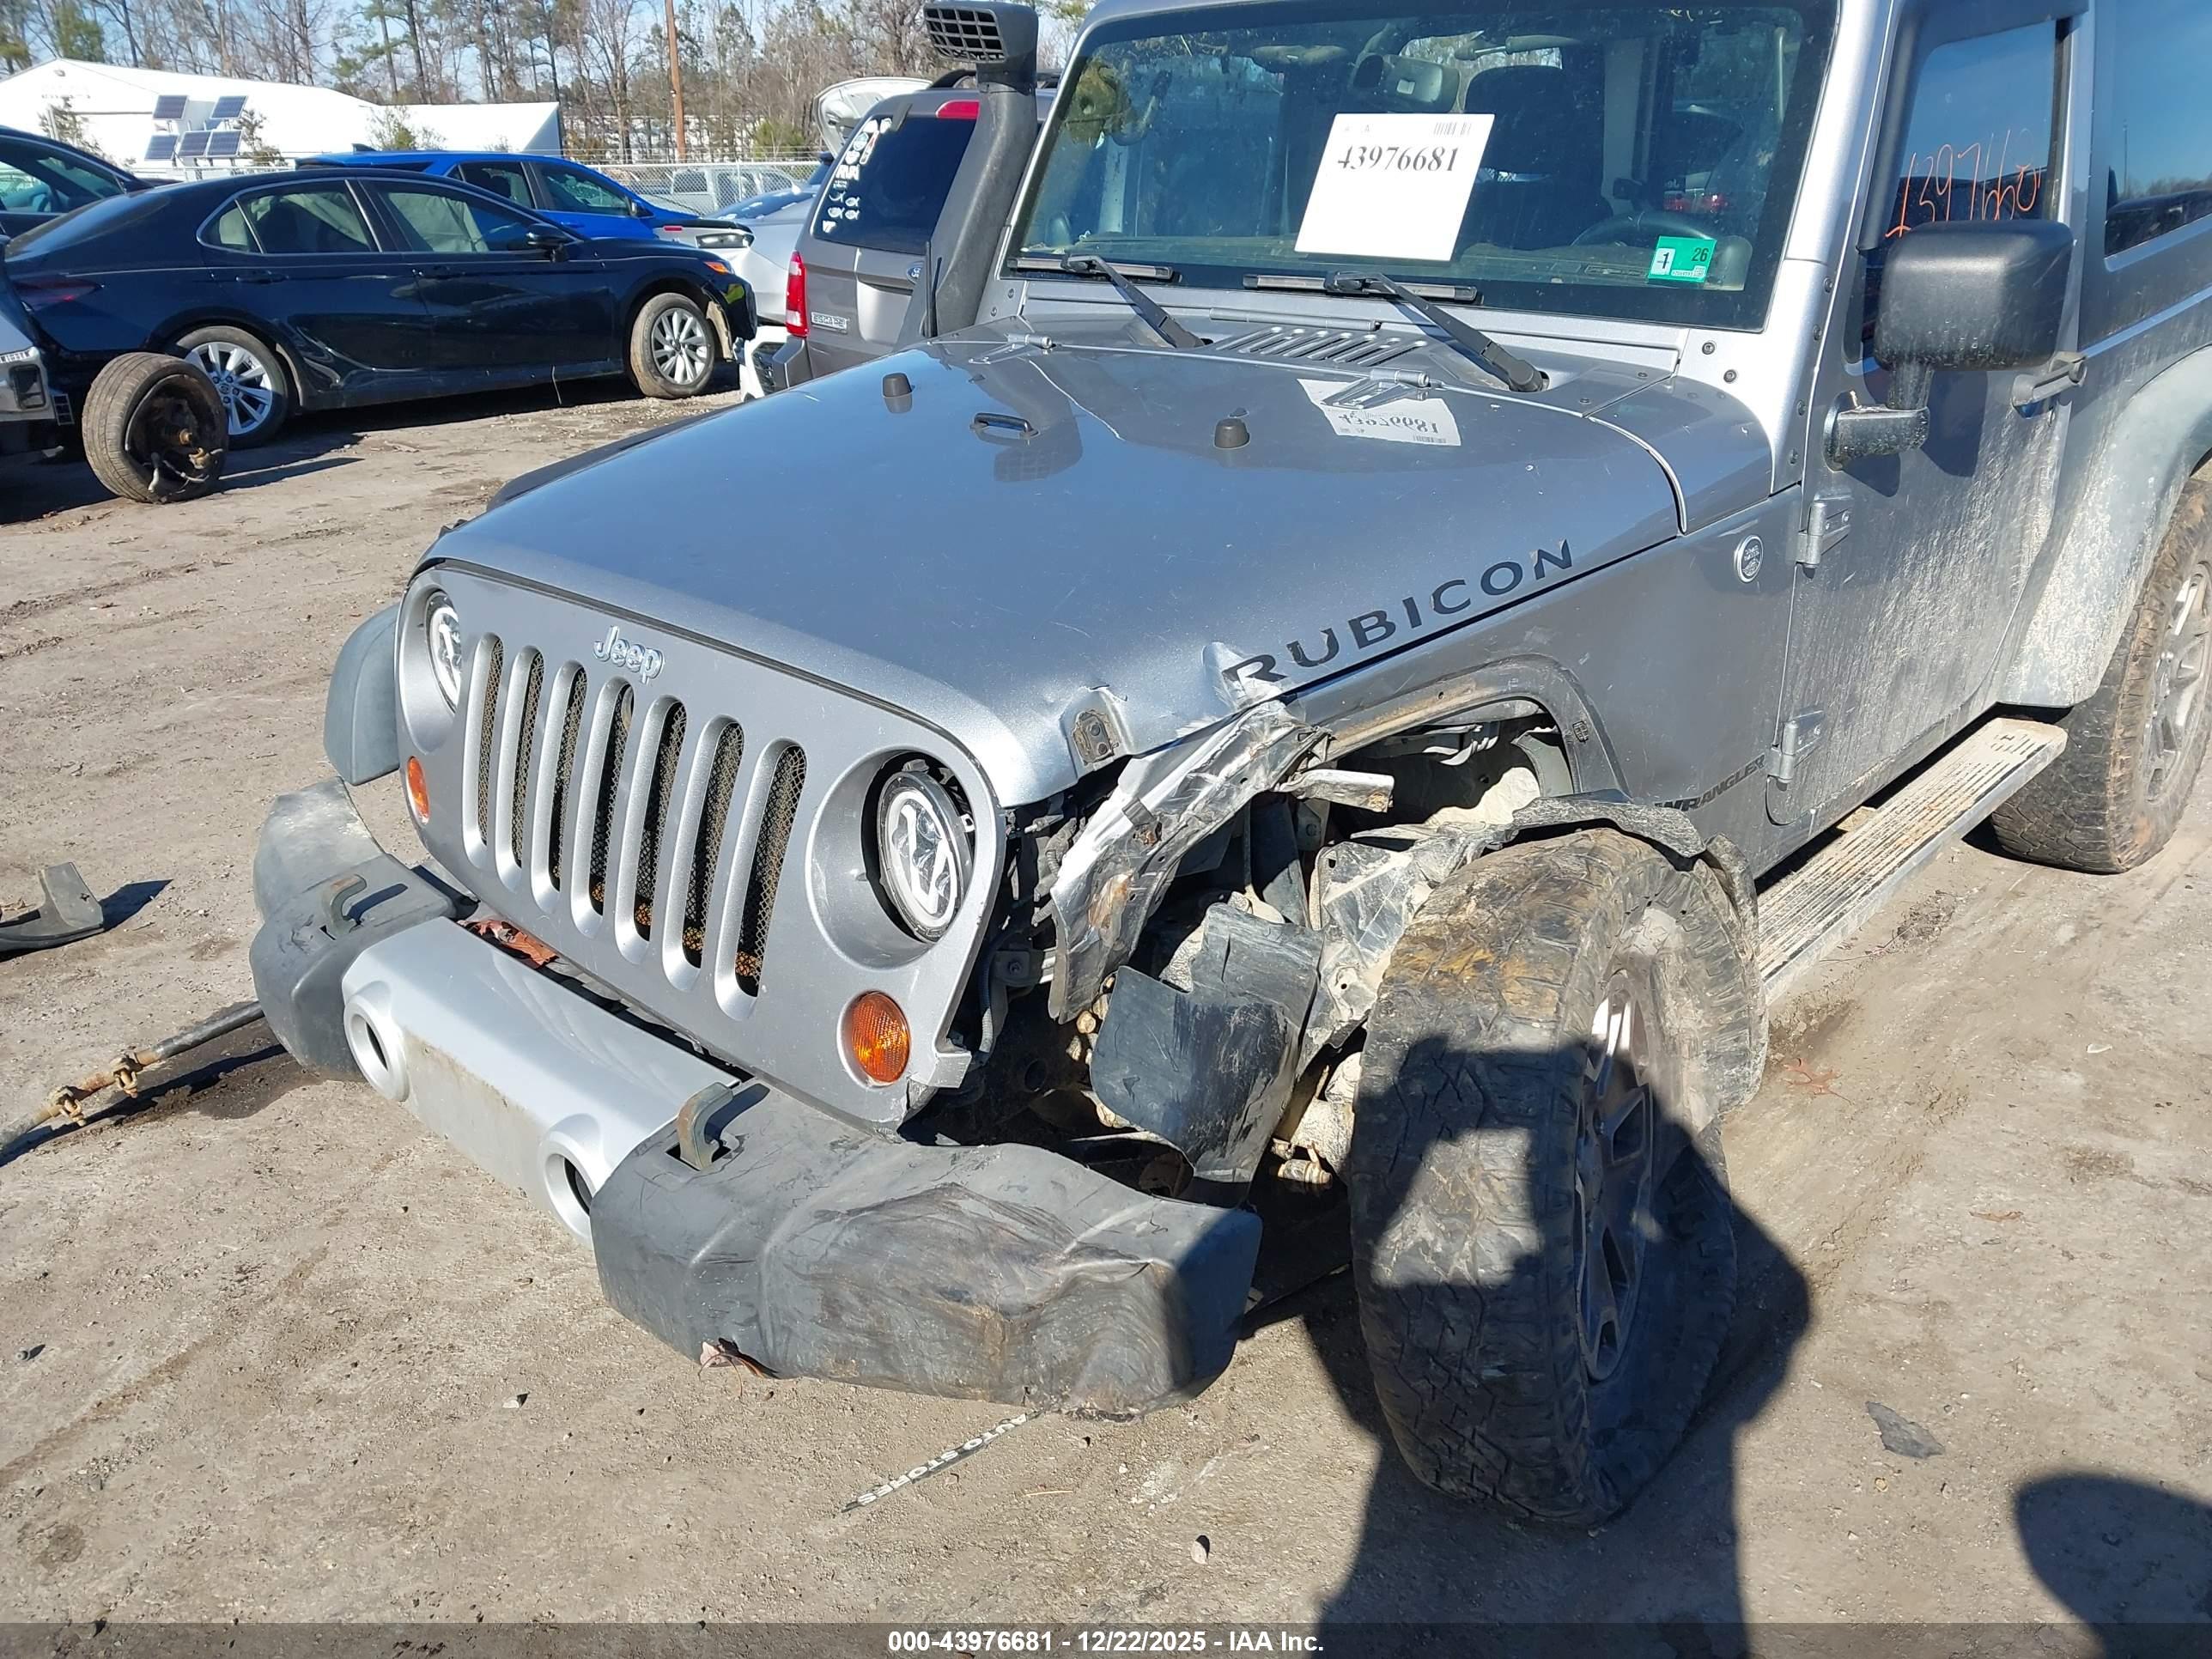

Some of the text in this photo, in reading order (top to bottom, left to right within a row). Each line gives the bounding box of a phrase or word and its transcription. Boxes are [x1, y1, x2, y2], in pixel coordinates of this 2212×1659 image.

[1338, 145, 1458, 171] 43976681
[1692, 247, 1709, 262] 26
[1222, 538, 1572, 684] RUBICON
[592, 626, 664, 684] Jeep
[857, 1413, 1027, 1506] AUTO STORES
